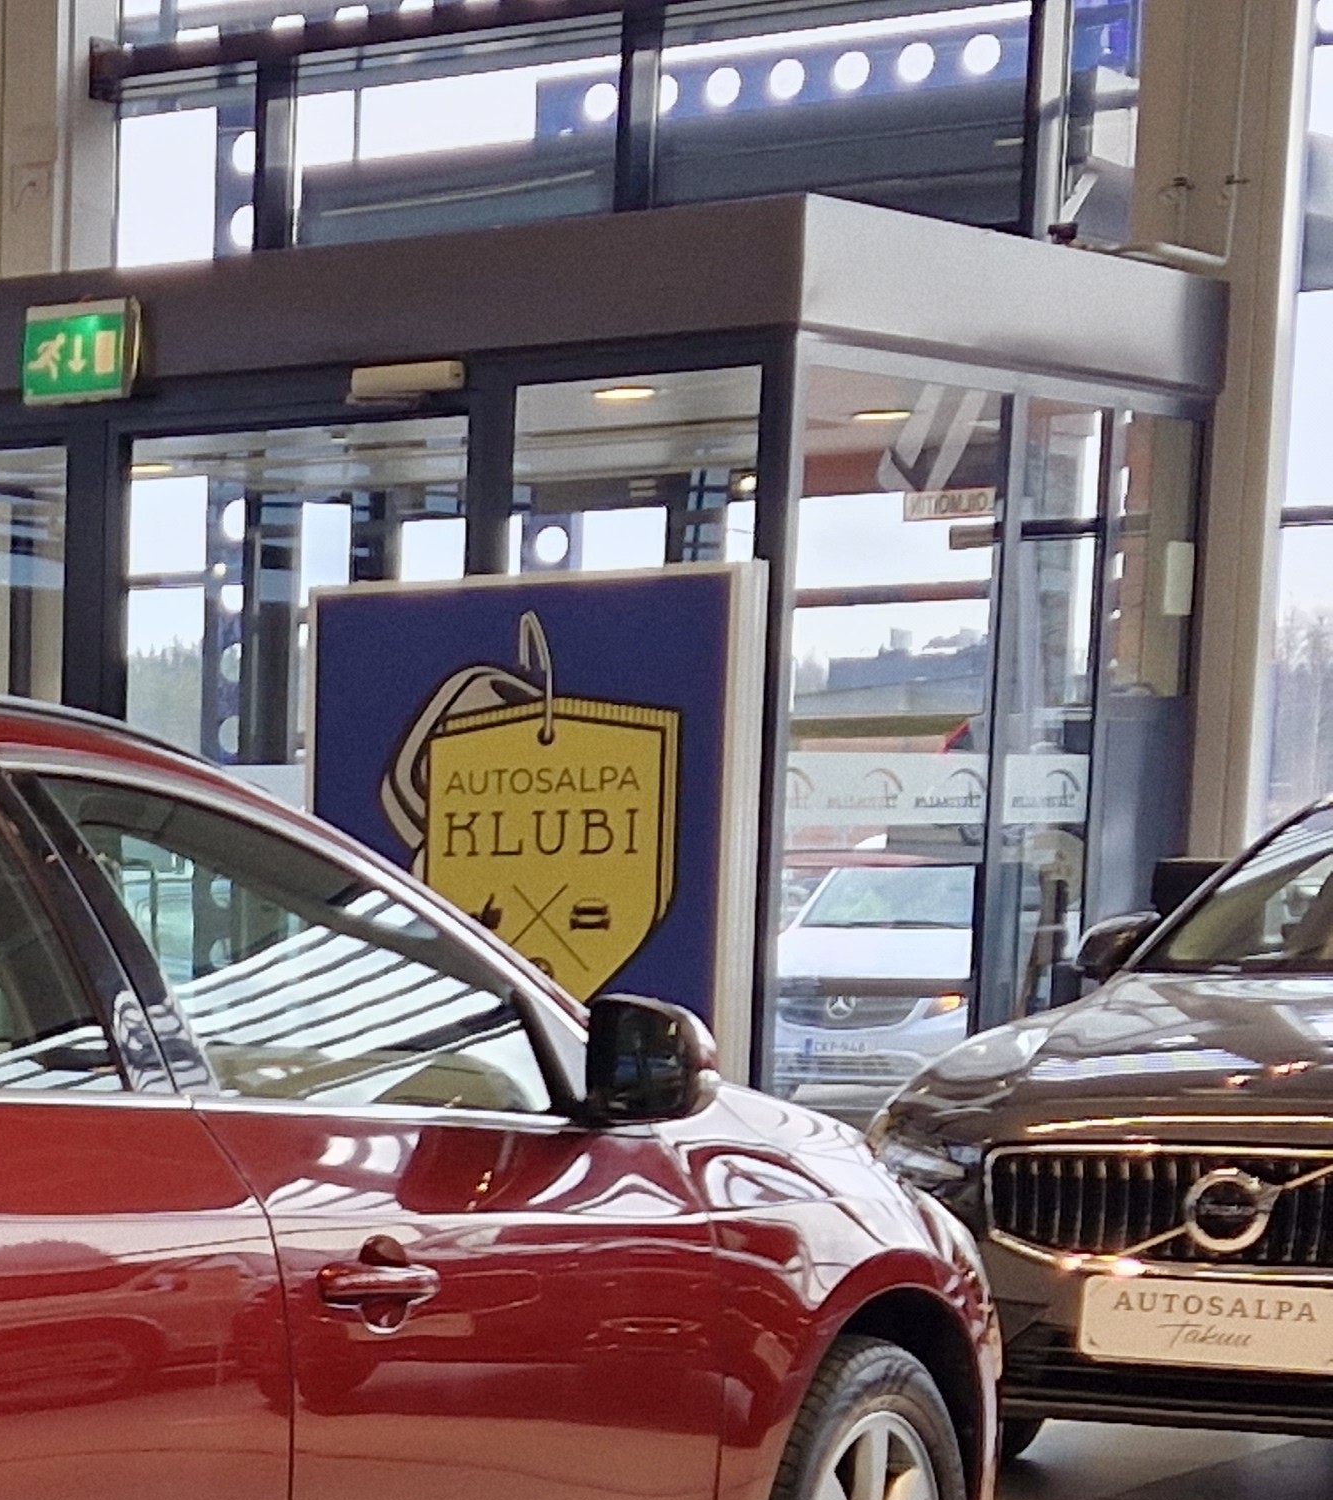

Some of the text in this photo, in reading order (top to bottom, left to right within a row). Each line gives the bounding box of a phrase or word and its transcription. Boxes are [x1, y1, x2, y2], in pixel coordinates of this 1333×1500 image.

[444, 765, 640, 796] AUTOSALPA
[442, 807, 640, 857] KLUBI
[1112, 1291, 1318, 1323] AUTOSALPA
[1156, 1322, 1252, 1347] Takuu
